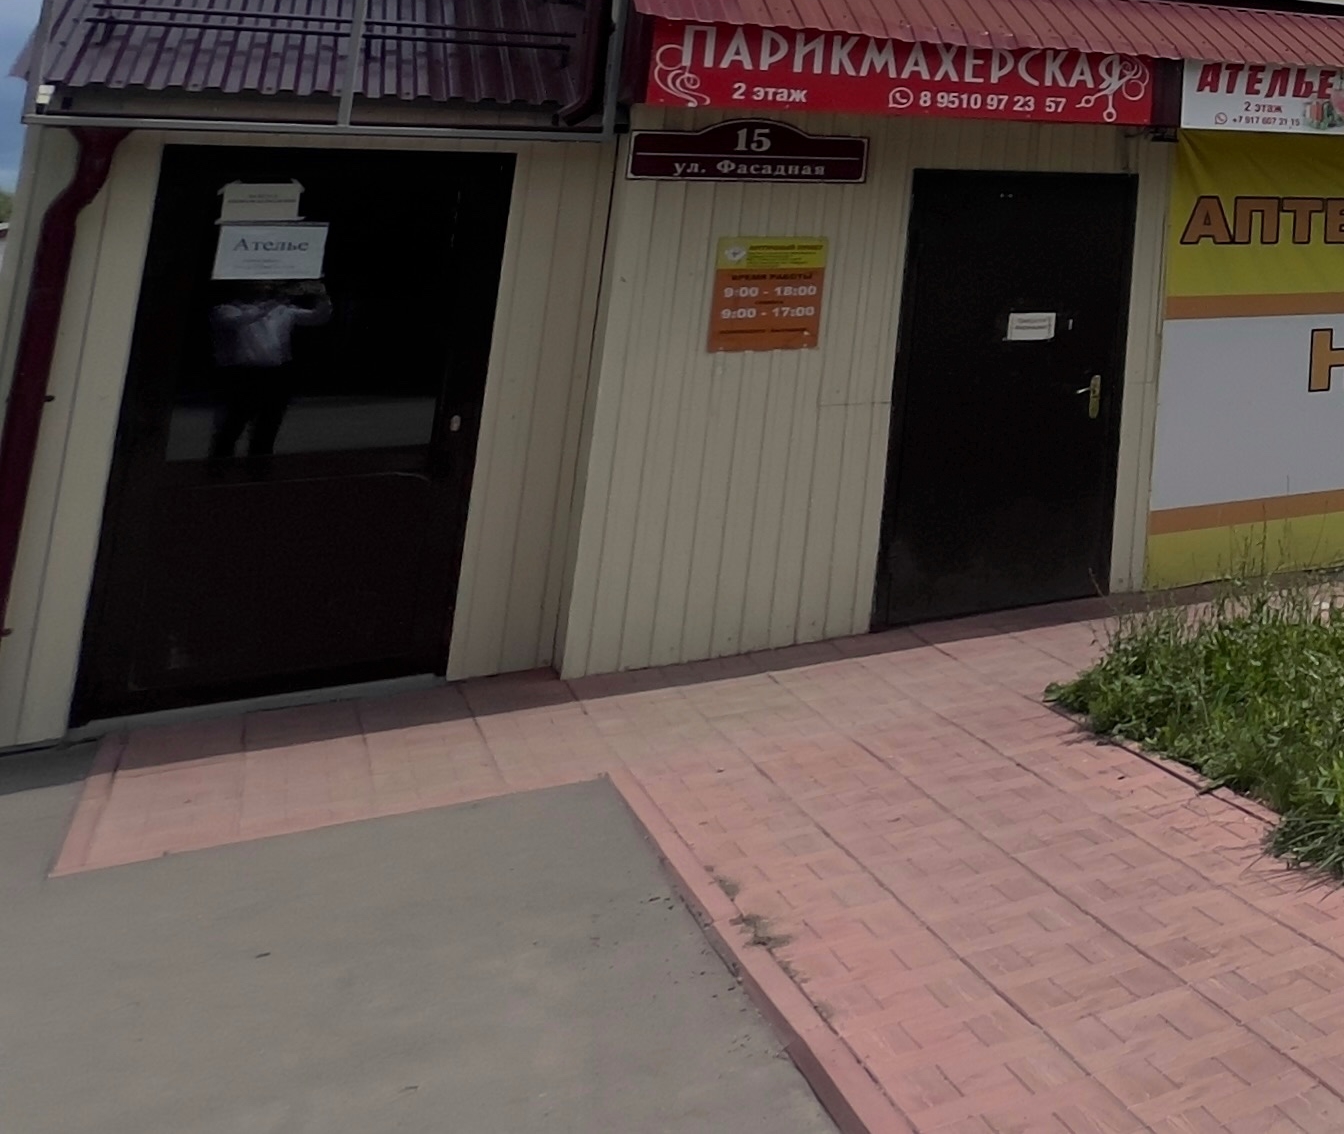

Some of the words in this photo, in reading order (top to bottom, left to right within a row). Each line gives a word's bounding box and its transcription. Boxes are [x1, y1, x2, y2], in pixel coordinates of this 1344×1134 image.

[681, 24, 1123, 91] ПАРИКМАХЕРСКАЯ
[1196, 62, 1337, 99] АТЕЛЬЕ
[732, 82, 747, 100] 2
[752, 87, 808, 103] этаж
[919, 91, 932, 107] 8
[936, 93, 982, 110] 9510
[986, 94, 1009, 111] 97
[1013, 95, 1035, 112] 23
[1045, 97, 1067, 113] 57
[1244, 101, 1251, 112] 2
[733, 128, 771, 152] 15
[673, 161, 706, 176] ул.
[716, 160, 825, 177] Фасадная
[232, 237, 309, 252] Ателье
[723, 286, 759, 298] 9:00
[774, 285, 817, 297] 18:00
[721, 308, 757, 319] 9:00
[772, 306, 815, 318] 17:00
